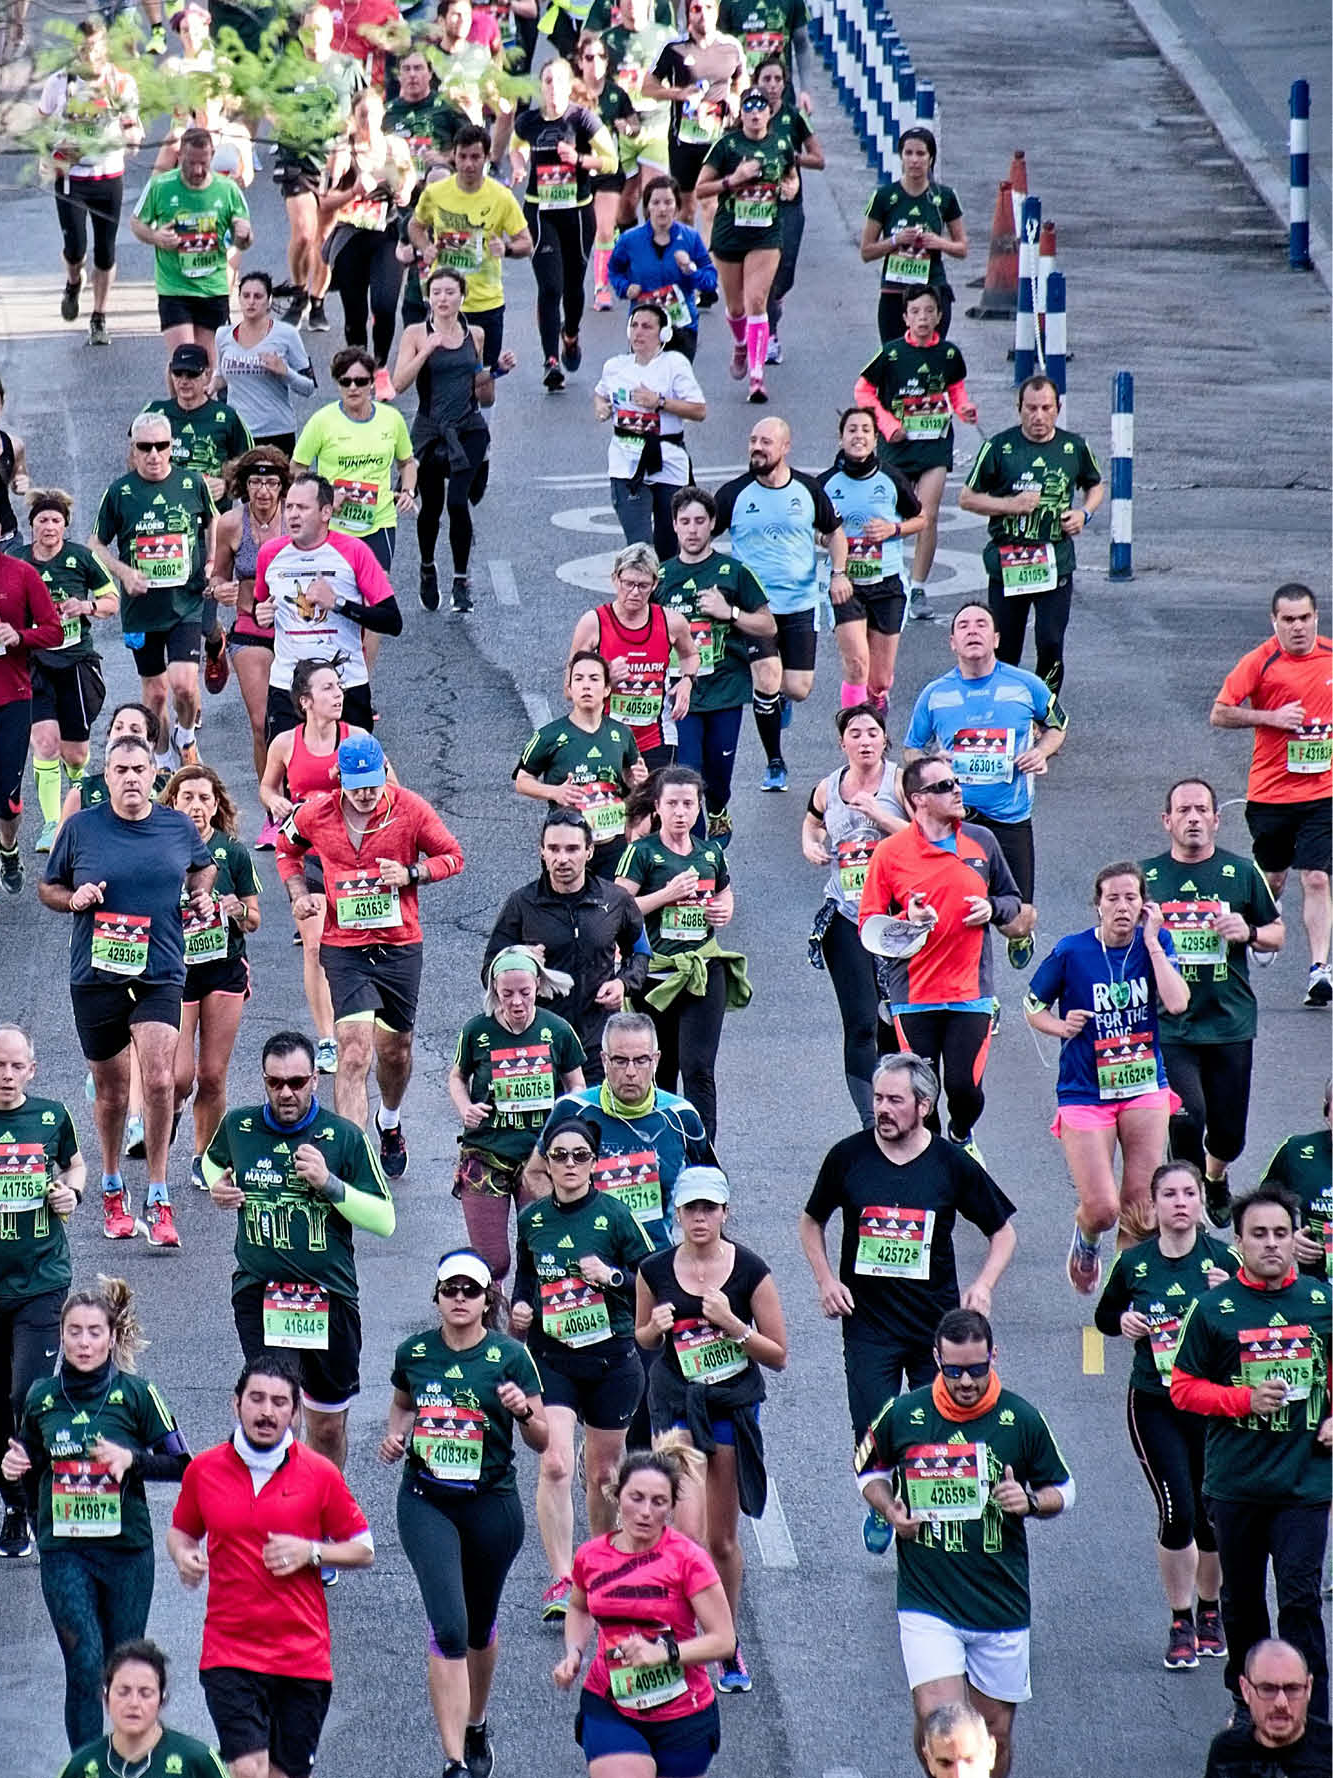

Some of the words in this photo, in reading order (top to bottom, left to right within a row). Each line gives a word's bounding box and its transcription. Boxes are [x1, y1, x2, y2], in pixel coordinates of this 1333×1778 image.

[135, 521, 164, 531] MADRID
[153, 563, 177, 577] 40802
[629, 663, 664, 672] NMARK
[969, 759, 996, 773] 26301
[355, 901, 383, 917] 43163
[1181, 936, 1211, 952] 42954
[107, 946, 136, 963] 42936
[1094, 1013, 1122, 1030] FOR
[1125, 1005, 1148, 1022] THE
[256, 1159, 272, 1170] edp
[244, 1172, 282, 1184] MADRID
[1, 1181, 35, 1198] 41756
[261, 1214, 271, 1239] 2017
[877, 1246, 911, 1264] 42572
[285, 1319, 316, 1335] 41644
[426, 1384, 442, 1395] edp
[417, 1398, 453, 1408] MADRID
[444, 1409, 457, 1418] edp
[935, 1447, 948, 1455] edp
[930, 1487, 966, 1505] 42659
